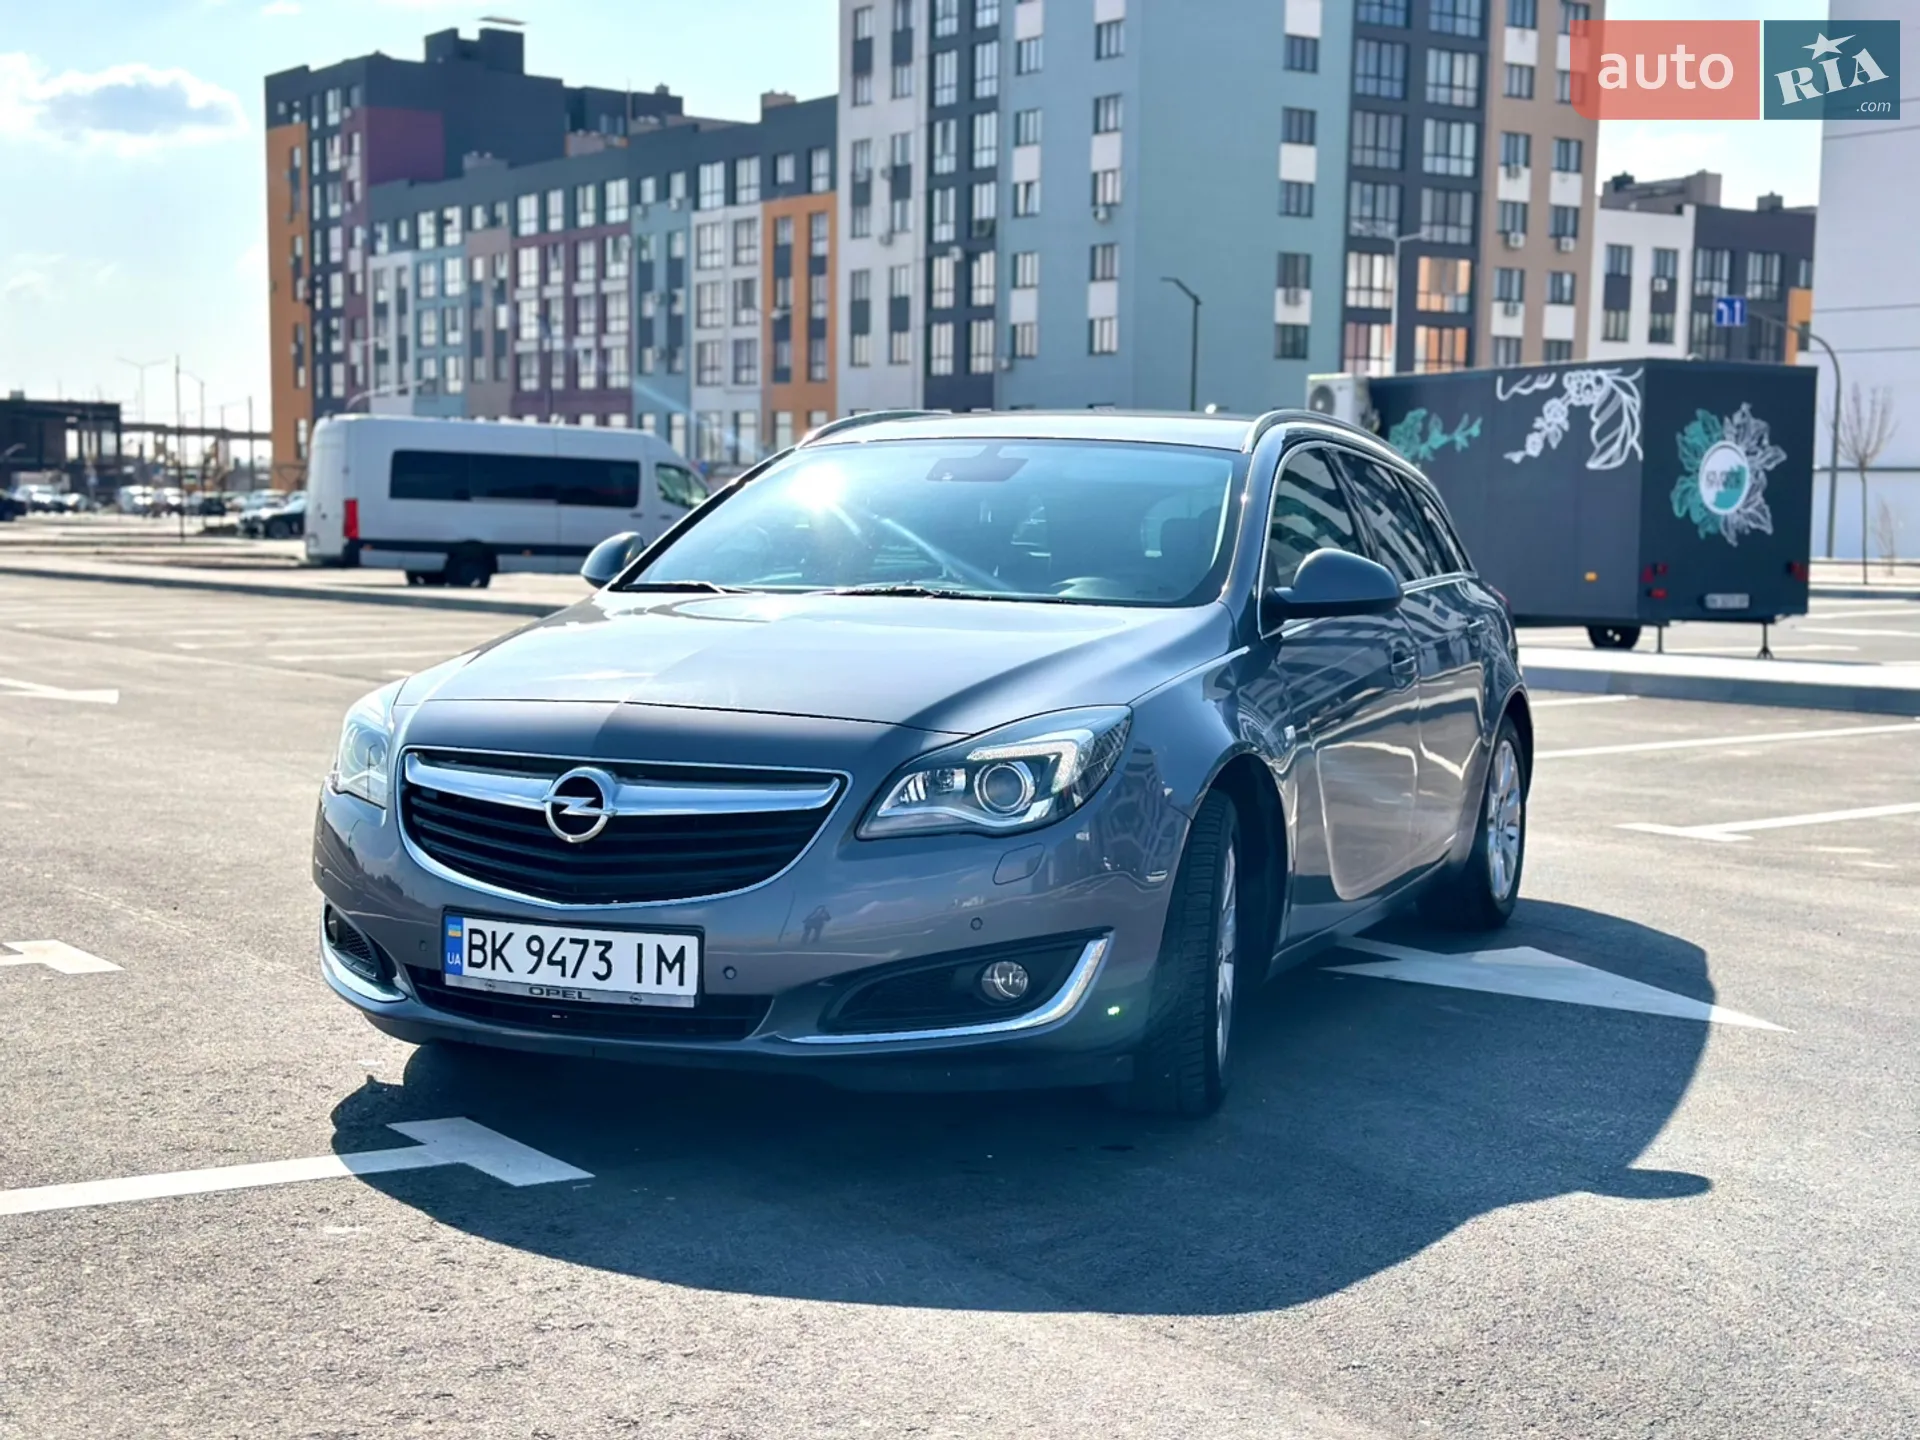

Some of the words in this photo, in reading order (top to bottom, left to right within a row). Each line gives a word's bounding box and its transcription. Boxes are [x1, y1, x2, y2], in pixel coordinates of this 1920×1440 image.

[447, 952, 462, 966] UA
[467, 928, 515, 973] BK
[525, 934, 614, 981] 9473
[636, 942, 686, 987] IM
[528, 986, 592, 1001] OPEL
